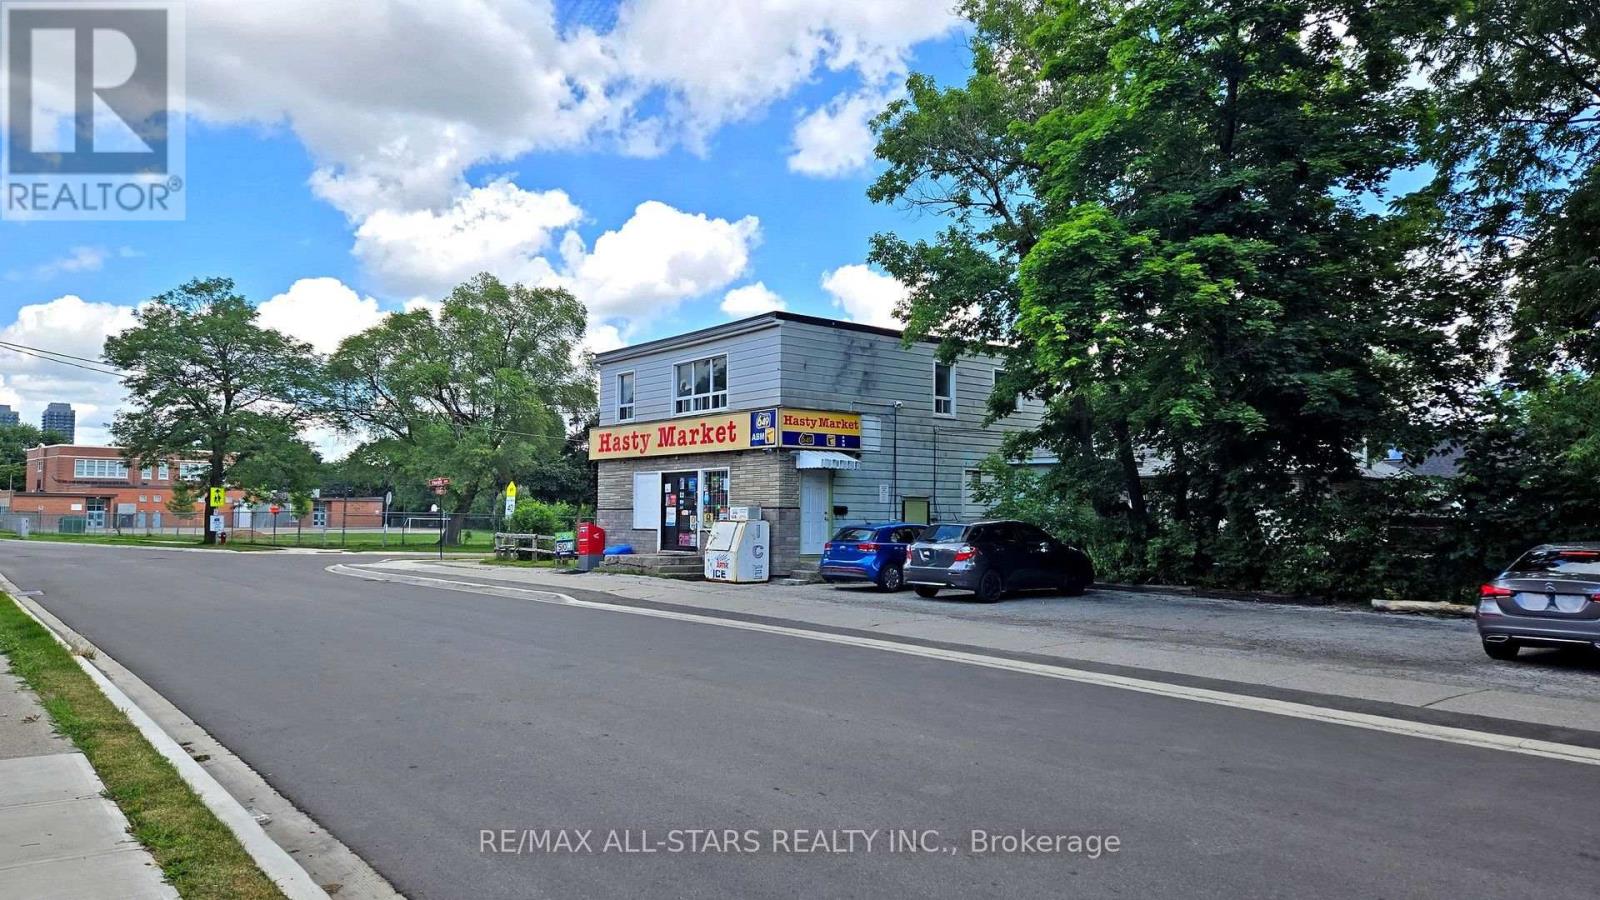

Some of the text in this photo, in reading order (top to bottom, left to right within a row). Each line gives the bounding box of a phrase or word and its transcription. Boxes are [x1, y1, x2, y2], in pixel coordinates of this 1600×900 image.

[783, 415, 860, 430] Hasty Market
[598, 420, 737, 454] Hasty Market
[712, 569, 726, 579] ICE
